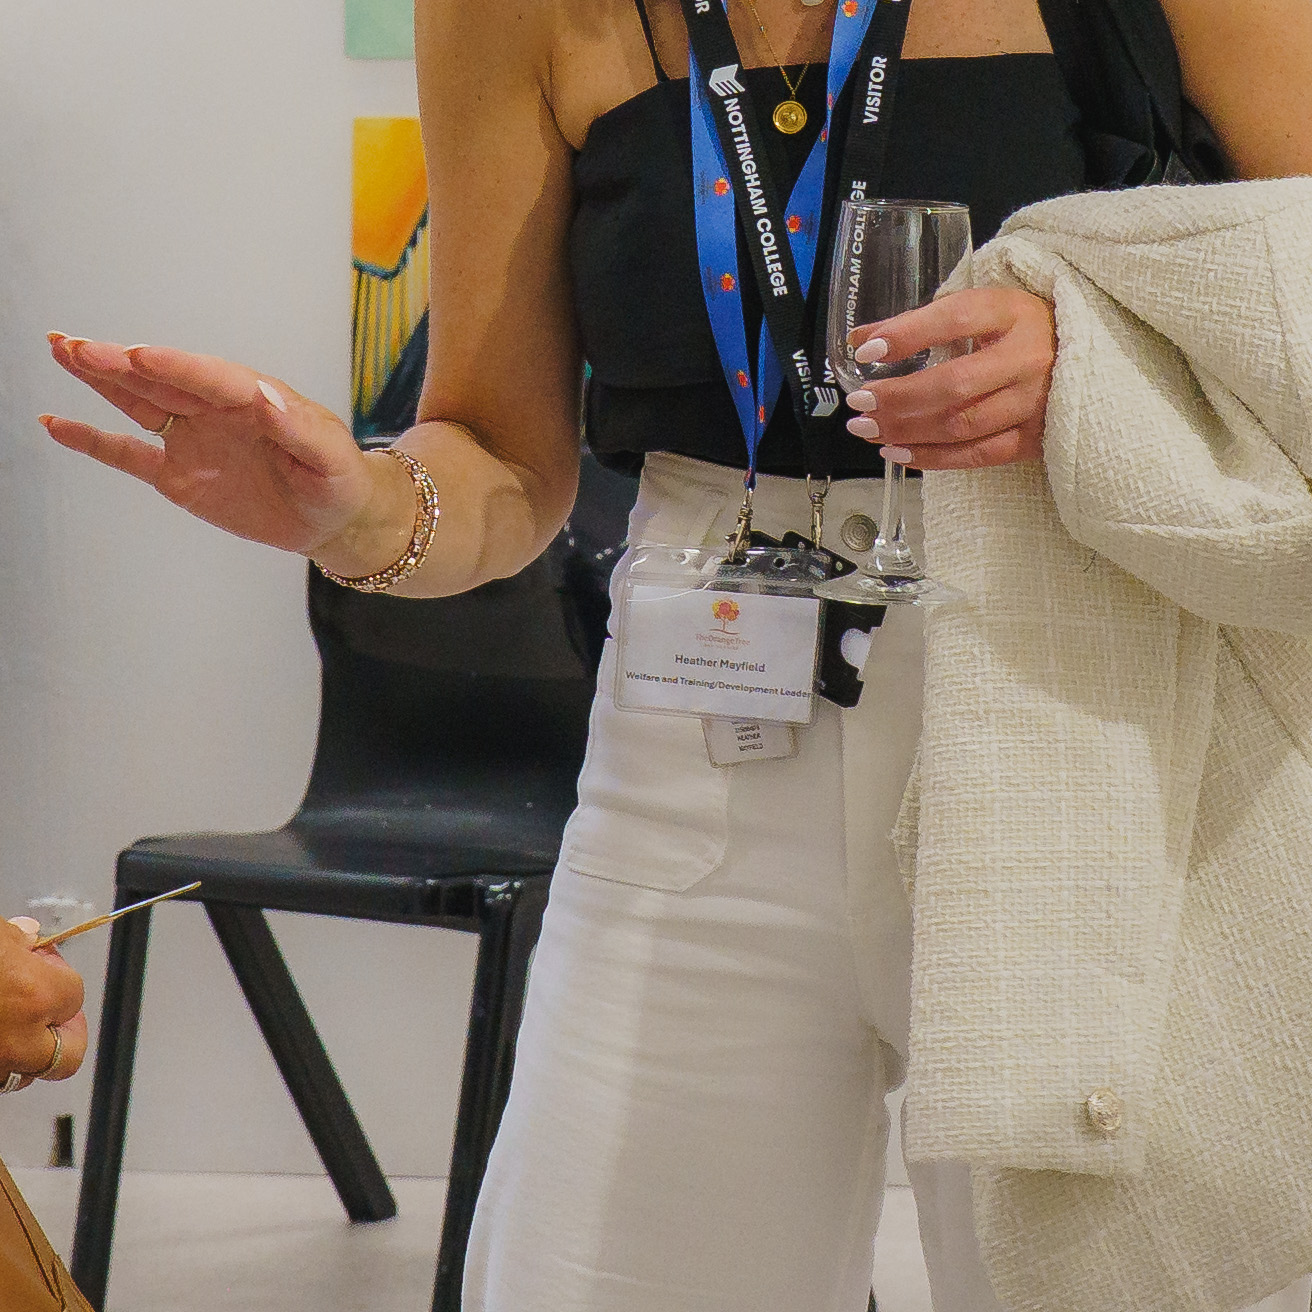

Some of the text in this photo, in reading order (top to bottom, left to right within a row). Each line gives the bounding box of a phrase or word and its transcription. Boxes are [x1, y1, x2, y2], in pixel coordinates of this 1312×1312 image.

[862, 56, 888, 124] VISITOR
[724, 97, 788, 297] NOTTINGHAM COLLEGE
[626, 671, 811, 698] Welfare and Training/Development Leader
[674, 654, 766, 673] Heather Mayfield
